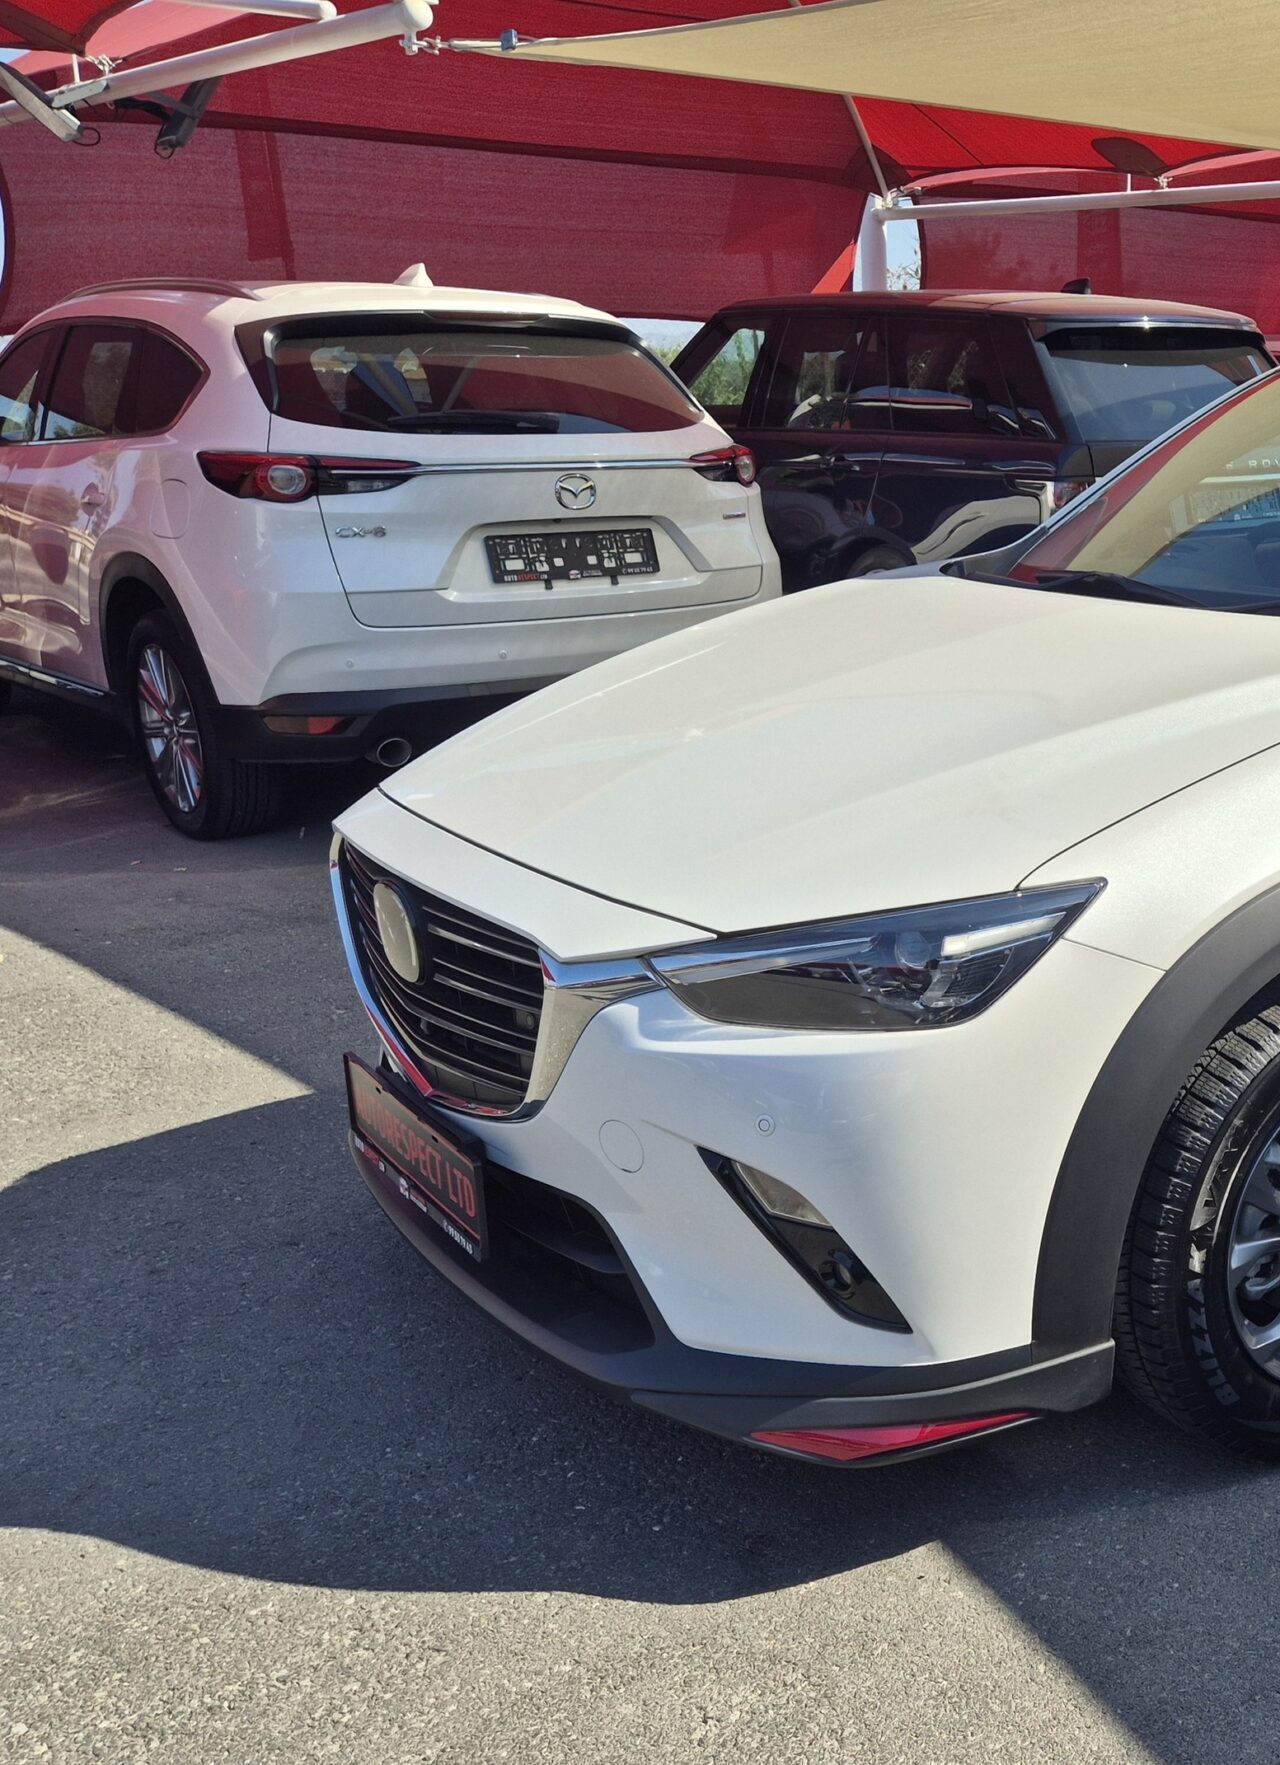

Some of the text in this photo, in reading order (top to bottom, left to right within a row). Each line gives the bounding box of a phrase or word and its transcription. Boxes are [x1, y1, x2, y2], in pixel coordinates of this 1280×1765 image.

[356, 1090, 442, 1191] AUTORESPECT
[446, 1160, 477, 1219] LTD
[1187, 1241, 1241, 1406] BLIZZAK
